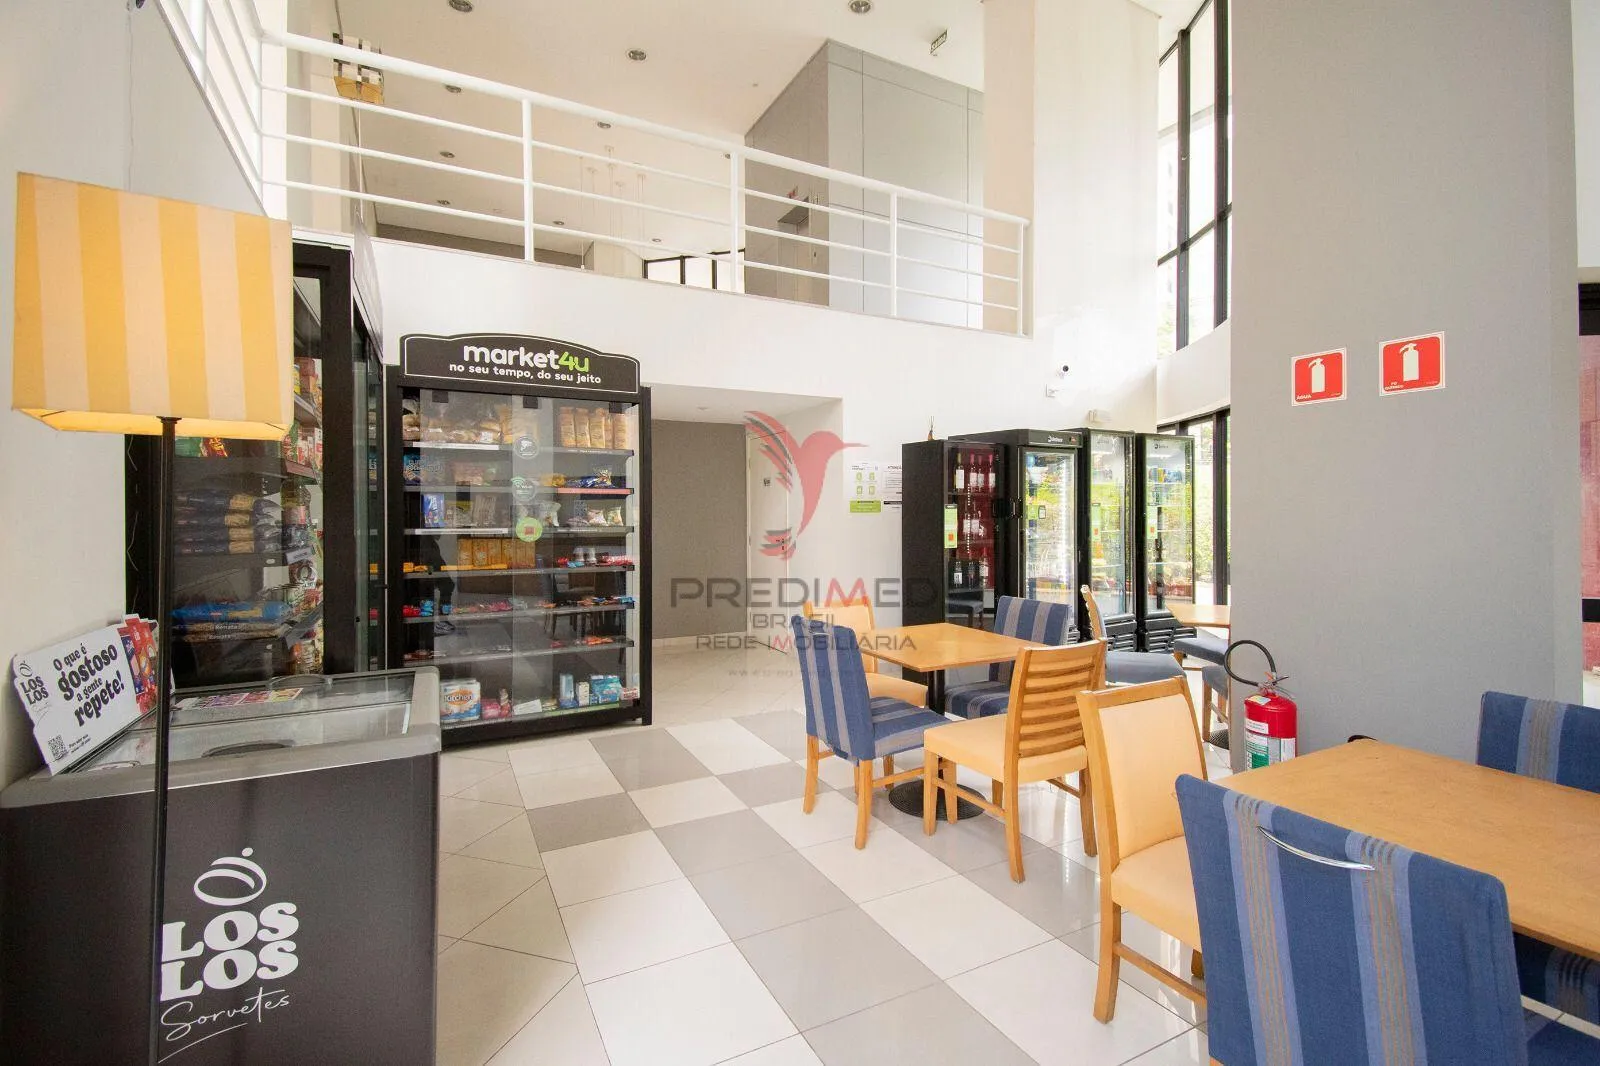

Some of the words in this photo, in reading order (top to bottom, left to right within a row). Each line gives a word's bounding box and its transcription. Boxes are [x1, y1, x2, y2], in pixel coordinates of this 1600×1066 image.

[463, 345, 590, 373] market4u
[450, 364, 464, 373] no
[468, 365, 489, 375] seu
[493, 366, 534, 380] tempo,
[537, 370, 551, 379] do
[554, 372, 573, 382] seu
[576, 372, 602, 384] jeito
[53, 658, 63, 671] O
[64, 648, 81, 667] que
[80, 642, 87, 654] é
[20, 675, 44, 694] LOS
[57, 644, 118, 701] gostoso
[25, 687, 49, 705] LOS
[74, 670, 125, 727] repete!
[76, 693, 83, 702] a
[82, 677, 104, 700] gente
[162, 902, 299, 961] LOS
[160, 940, 299, 1001] LOS
[160, 986, 290, 1042] Sorvetes
